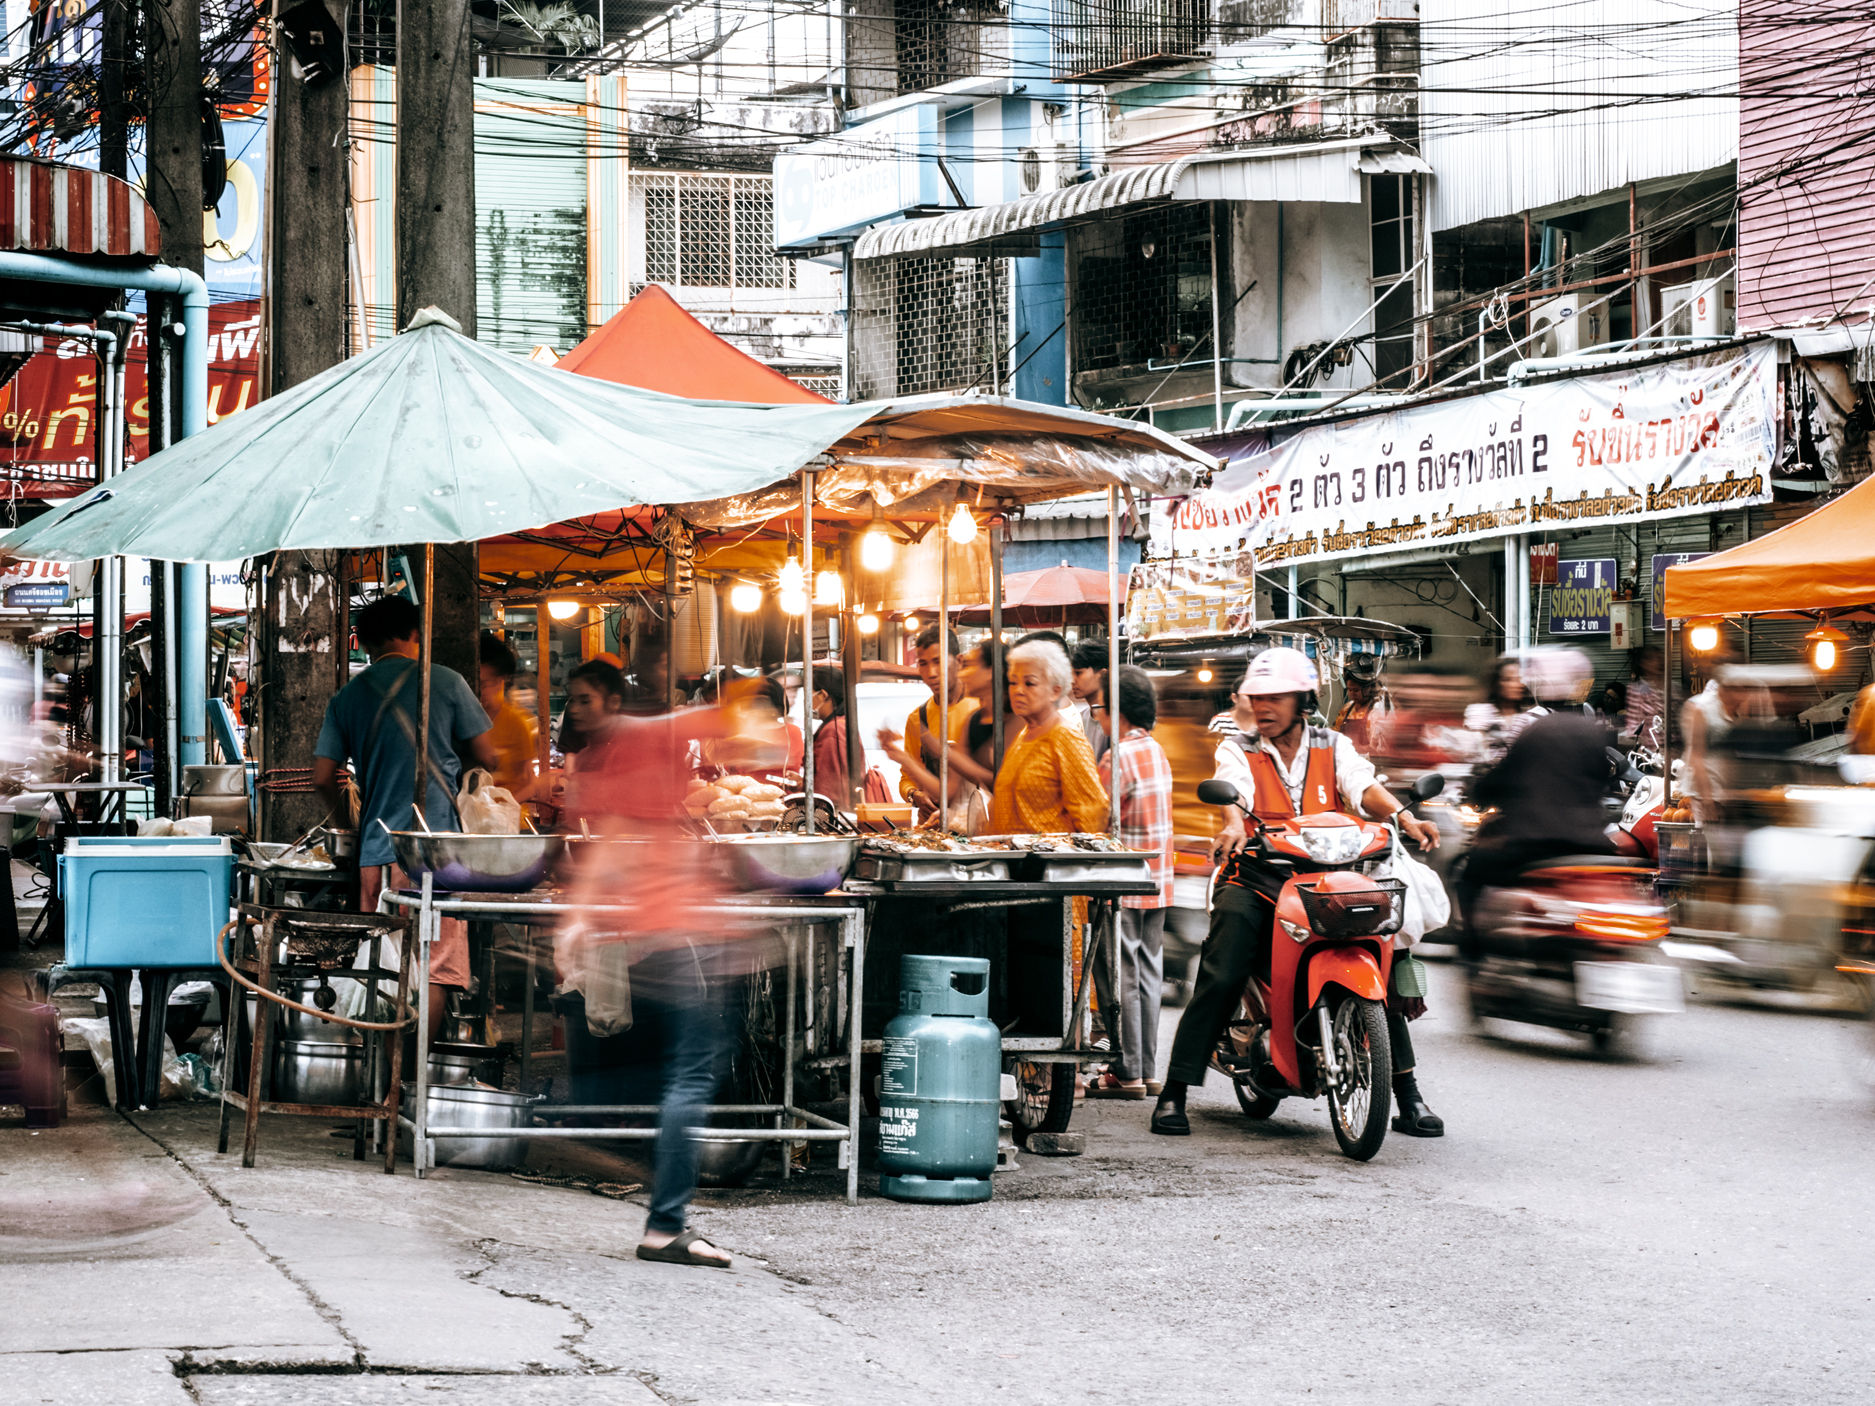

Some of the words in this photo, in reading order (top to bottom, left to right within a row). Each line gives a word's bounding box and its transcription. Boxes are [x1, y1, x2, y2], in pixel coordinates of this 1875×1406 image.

[1290, 478, 1303, 513] 2
[1314, 453, 1342, 509] ตัว
[1352, 467, 1366, 503] 3
[1376, 441, 1406, 499] ตัว
[1532, 433, 1548, 473] 2
[1581, 619, 1586, 631] 2
[1317, 784, 1328, 805] 5
